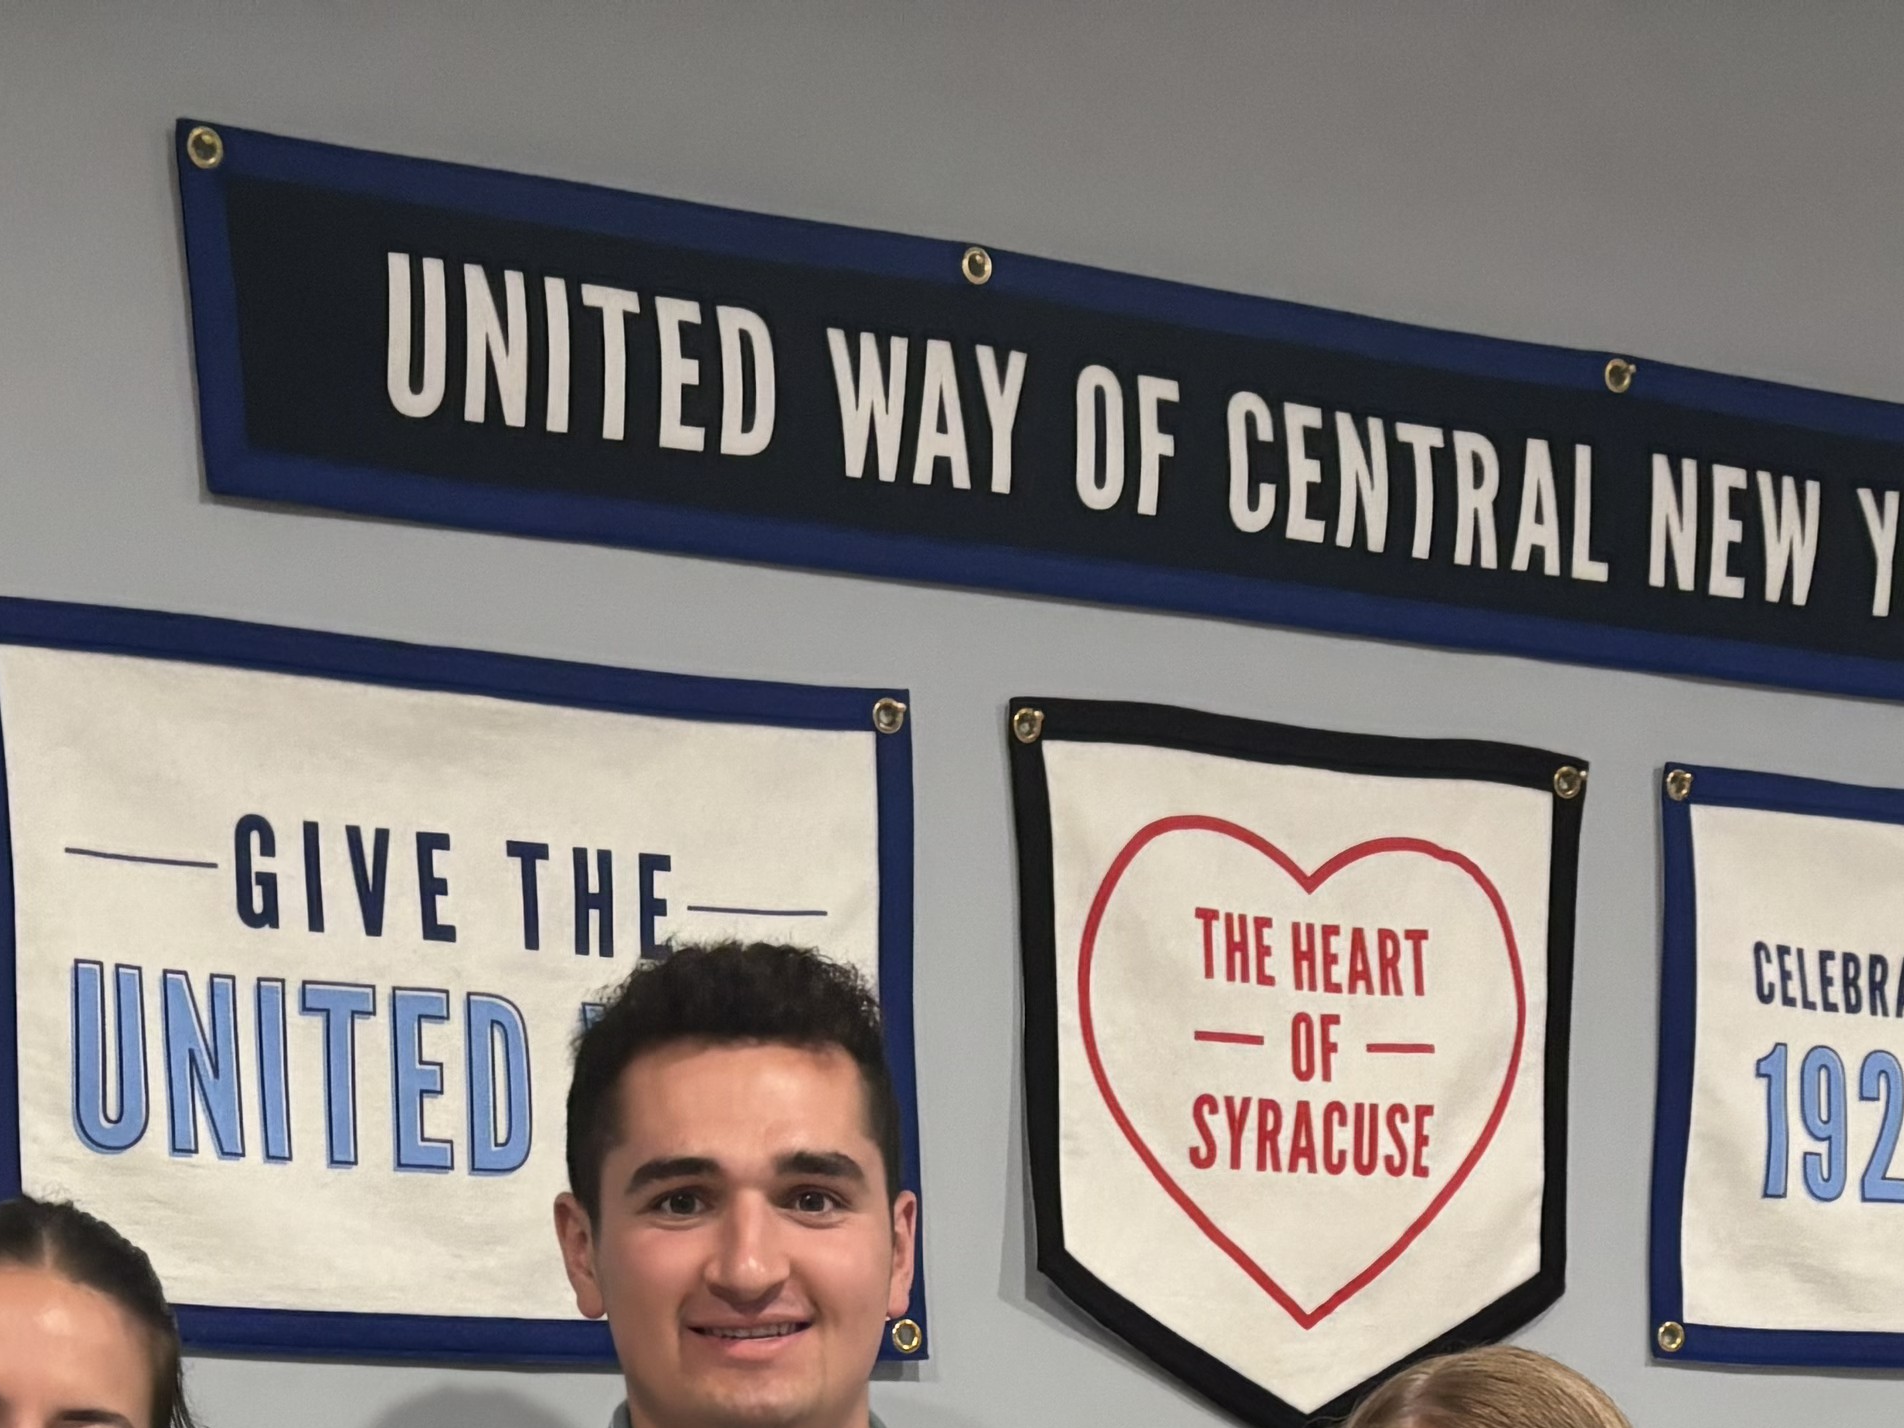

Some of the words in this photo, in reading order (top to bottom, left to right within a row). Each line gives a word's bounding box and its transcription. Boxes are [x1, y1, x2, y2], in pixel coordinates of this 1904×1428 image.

[386, 252, 777, 455] UNITED
[827, 326, 1028, 494] WAY
[1075, 364, 1182, 514] OF
[1227, 390, 1608, 582] CENTRAL
[1649, 454, 1822, 605] NEW
[234, 814, 456, 943] GIVE
[506, 840, 672, 960] THE
[1195, 907, 1275, 986] THE
[1292, 921, 1429, 997] HEART
[72, 959, 533, 1177] UNITED
[1291, 1012, 1341, 1082] OF
[1189, 1093, 1435, 1178] SYRACUSE
